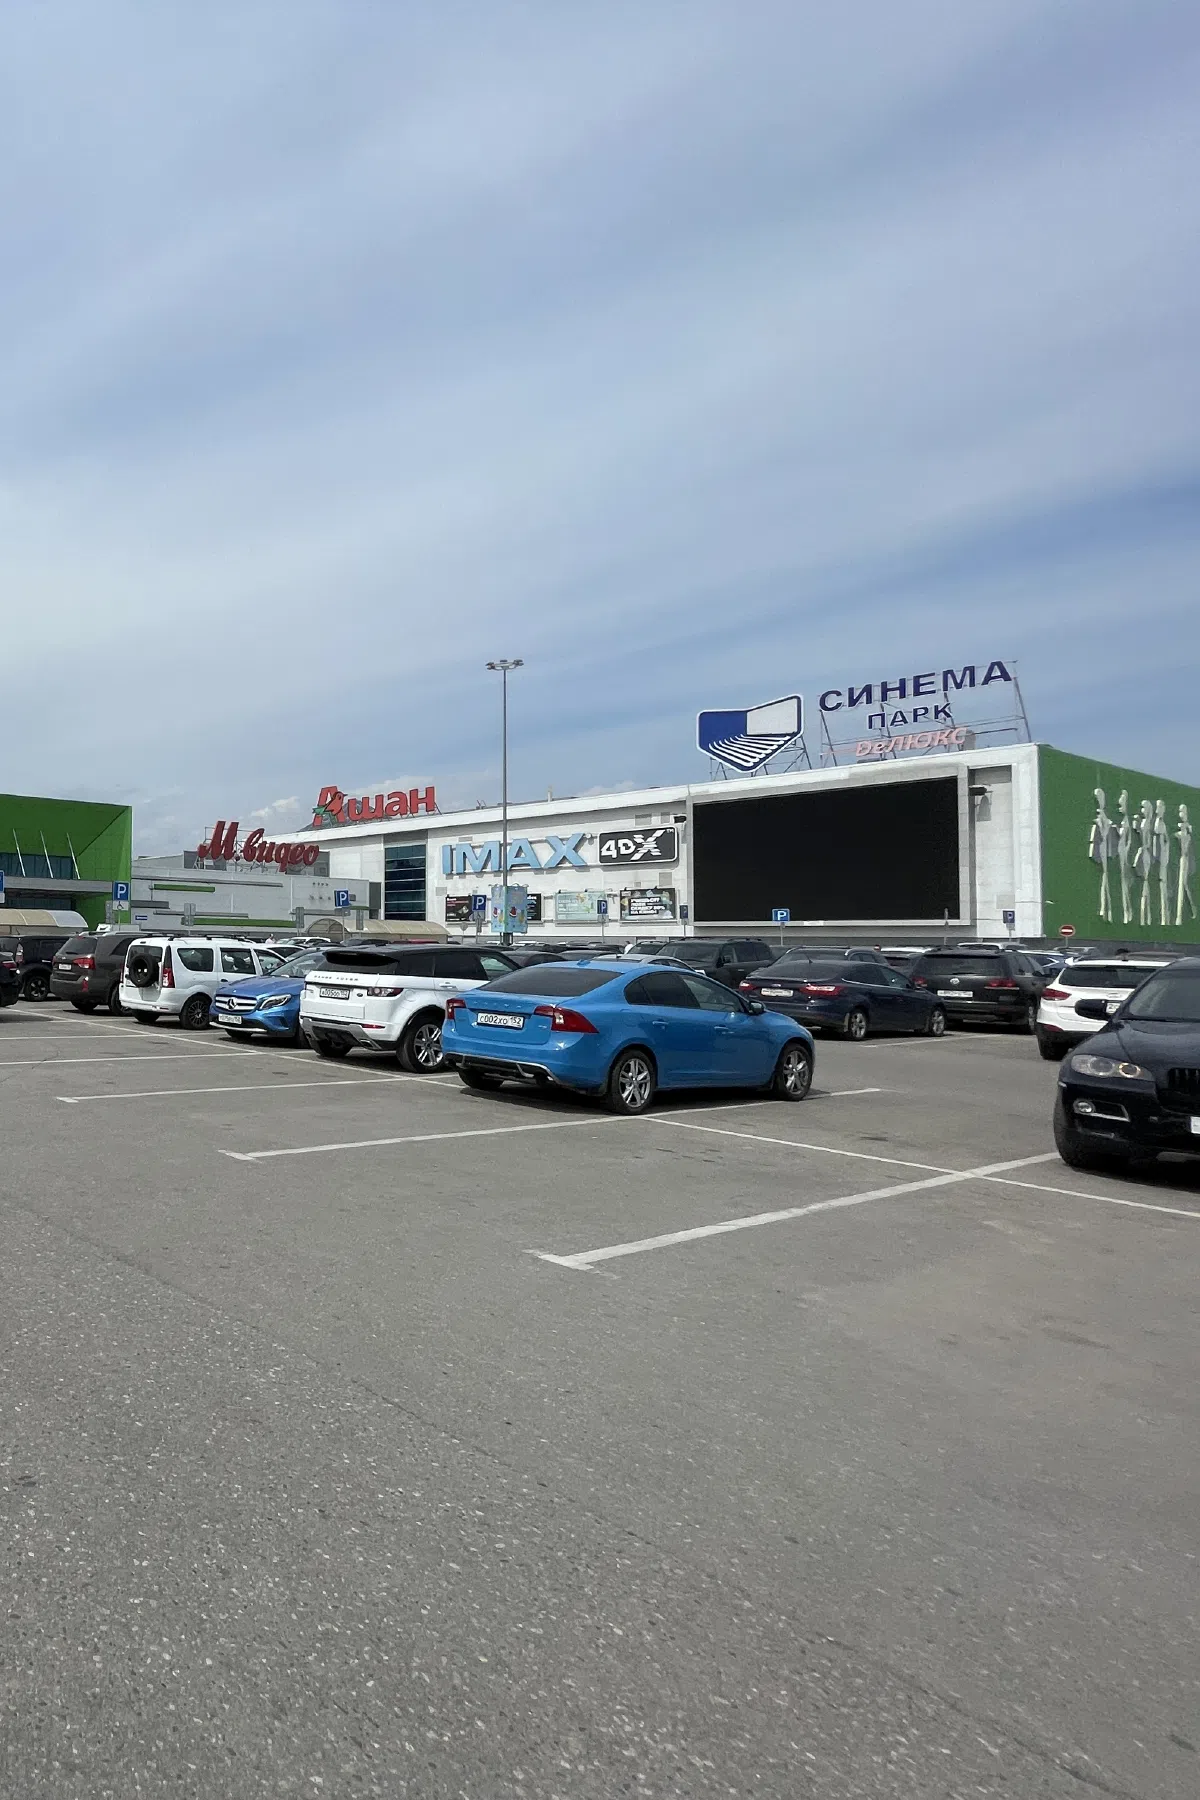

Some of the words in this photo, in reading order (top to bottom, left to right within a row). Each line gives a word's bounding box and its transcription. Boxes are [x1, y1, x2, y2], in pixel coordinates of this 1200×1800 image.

[819, 660, 1013, 711] СИНЕМА
[868, 702, 954, 729] ПАРК
[313, 785, 436, 827] Ашан
[197, 820, 320, 873] М.видео
[442, 832, 588, 875] IMAX
[600, 829, 666, 861] 4DX
[118, 884, 127, 899] P
[340, 891, 347, 906] P
[476, 896, 485, 910] P
[778, 911, 787, 920] P
